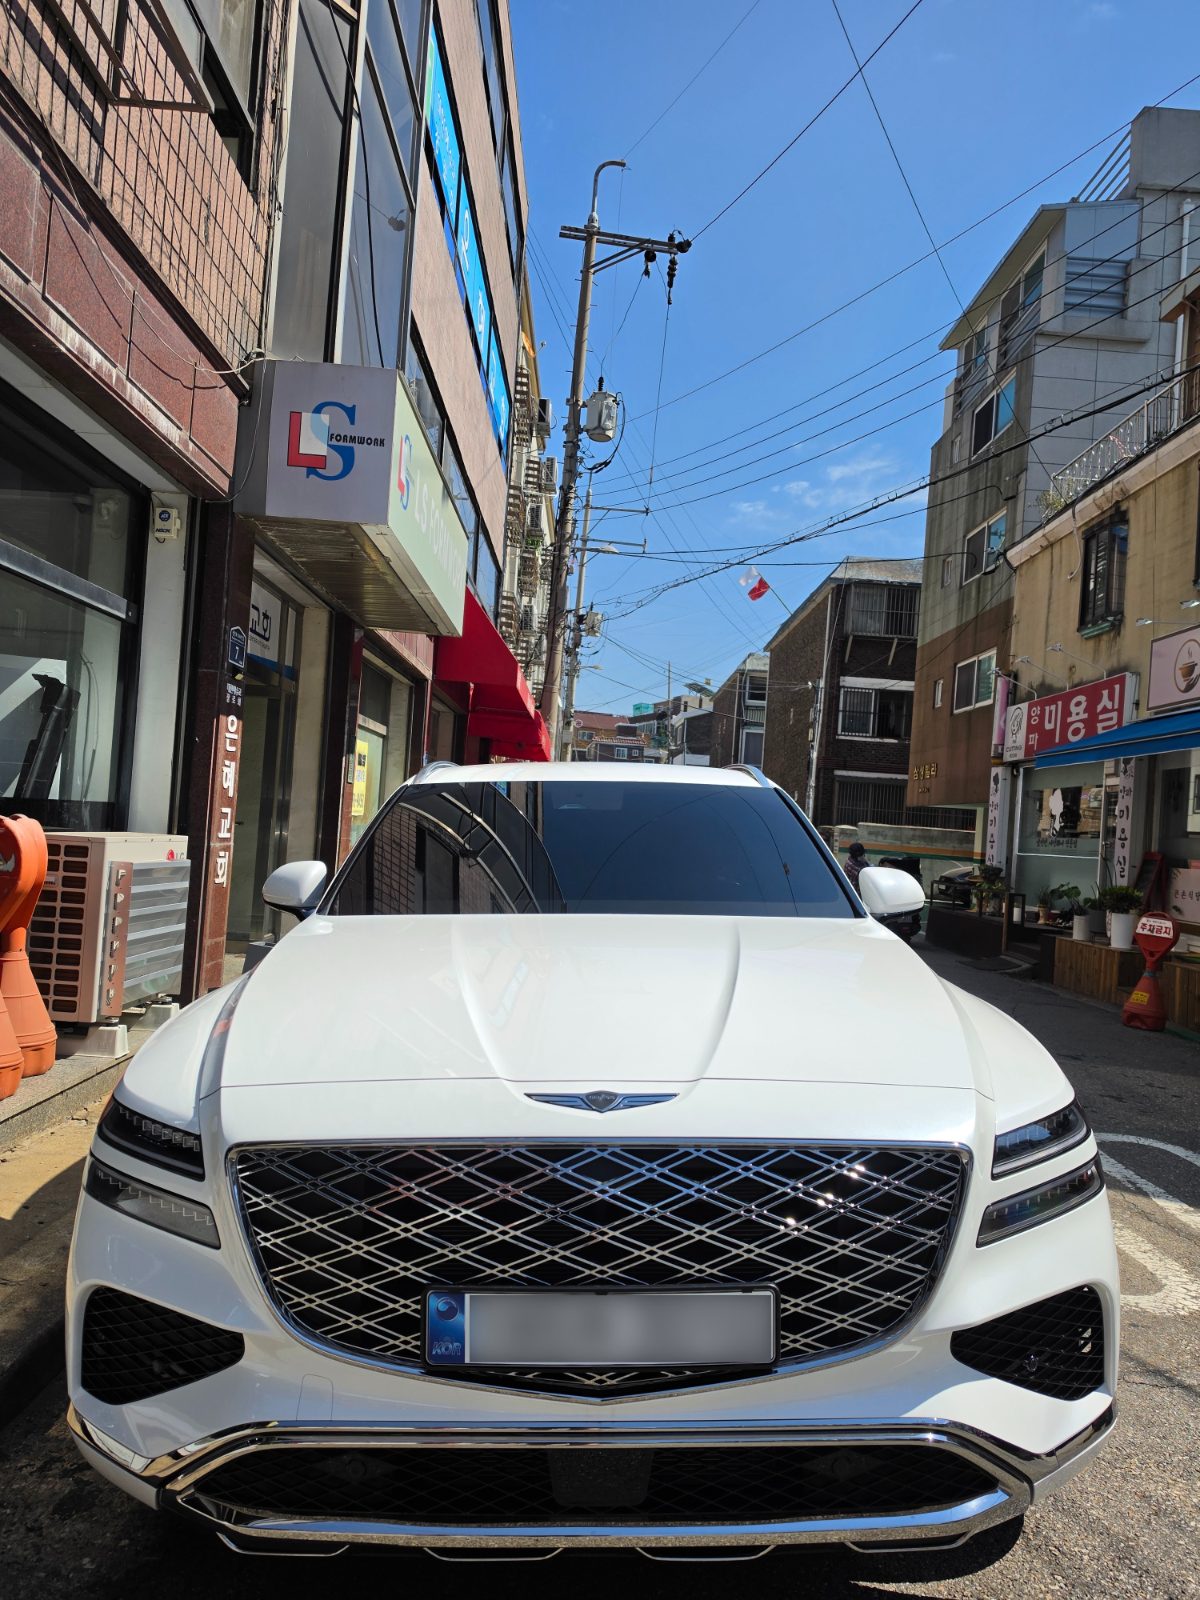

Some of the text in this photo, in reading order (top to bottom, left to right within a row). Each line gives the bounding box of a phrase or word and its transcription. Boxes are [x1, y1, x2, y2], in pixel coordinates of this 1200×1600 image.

[287, 401, 356, 481] LS
[328, 432, 386, 448] FORMWORK
[235, 646, 240, 660] 7
[1028, 684, 1121, 751] 양파 미용실
[213, 714, 239, 889] 은혜교회
[1116, 805, 1130, 879] 미용실
[1140, 922, 1171, 936] 주차금지
[432, 1340, 462, 1356] KOR
